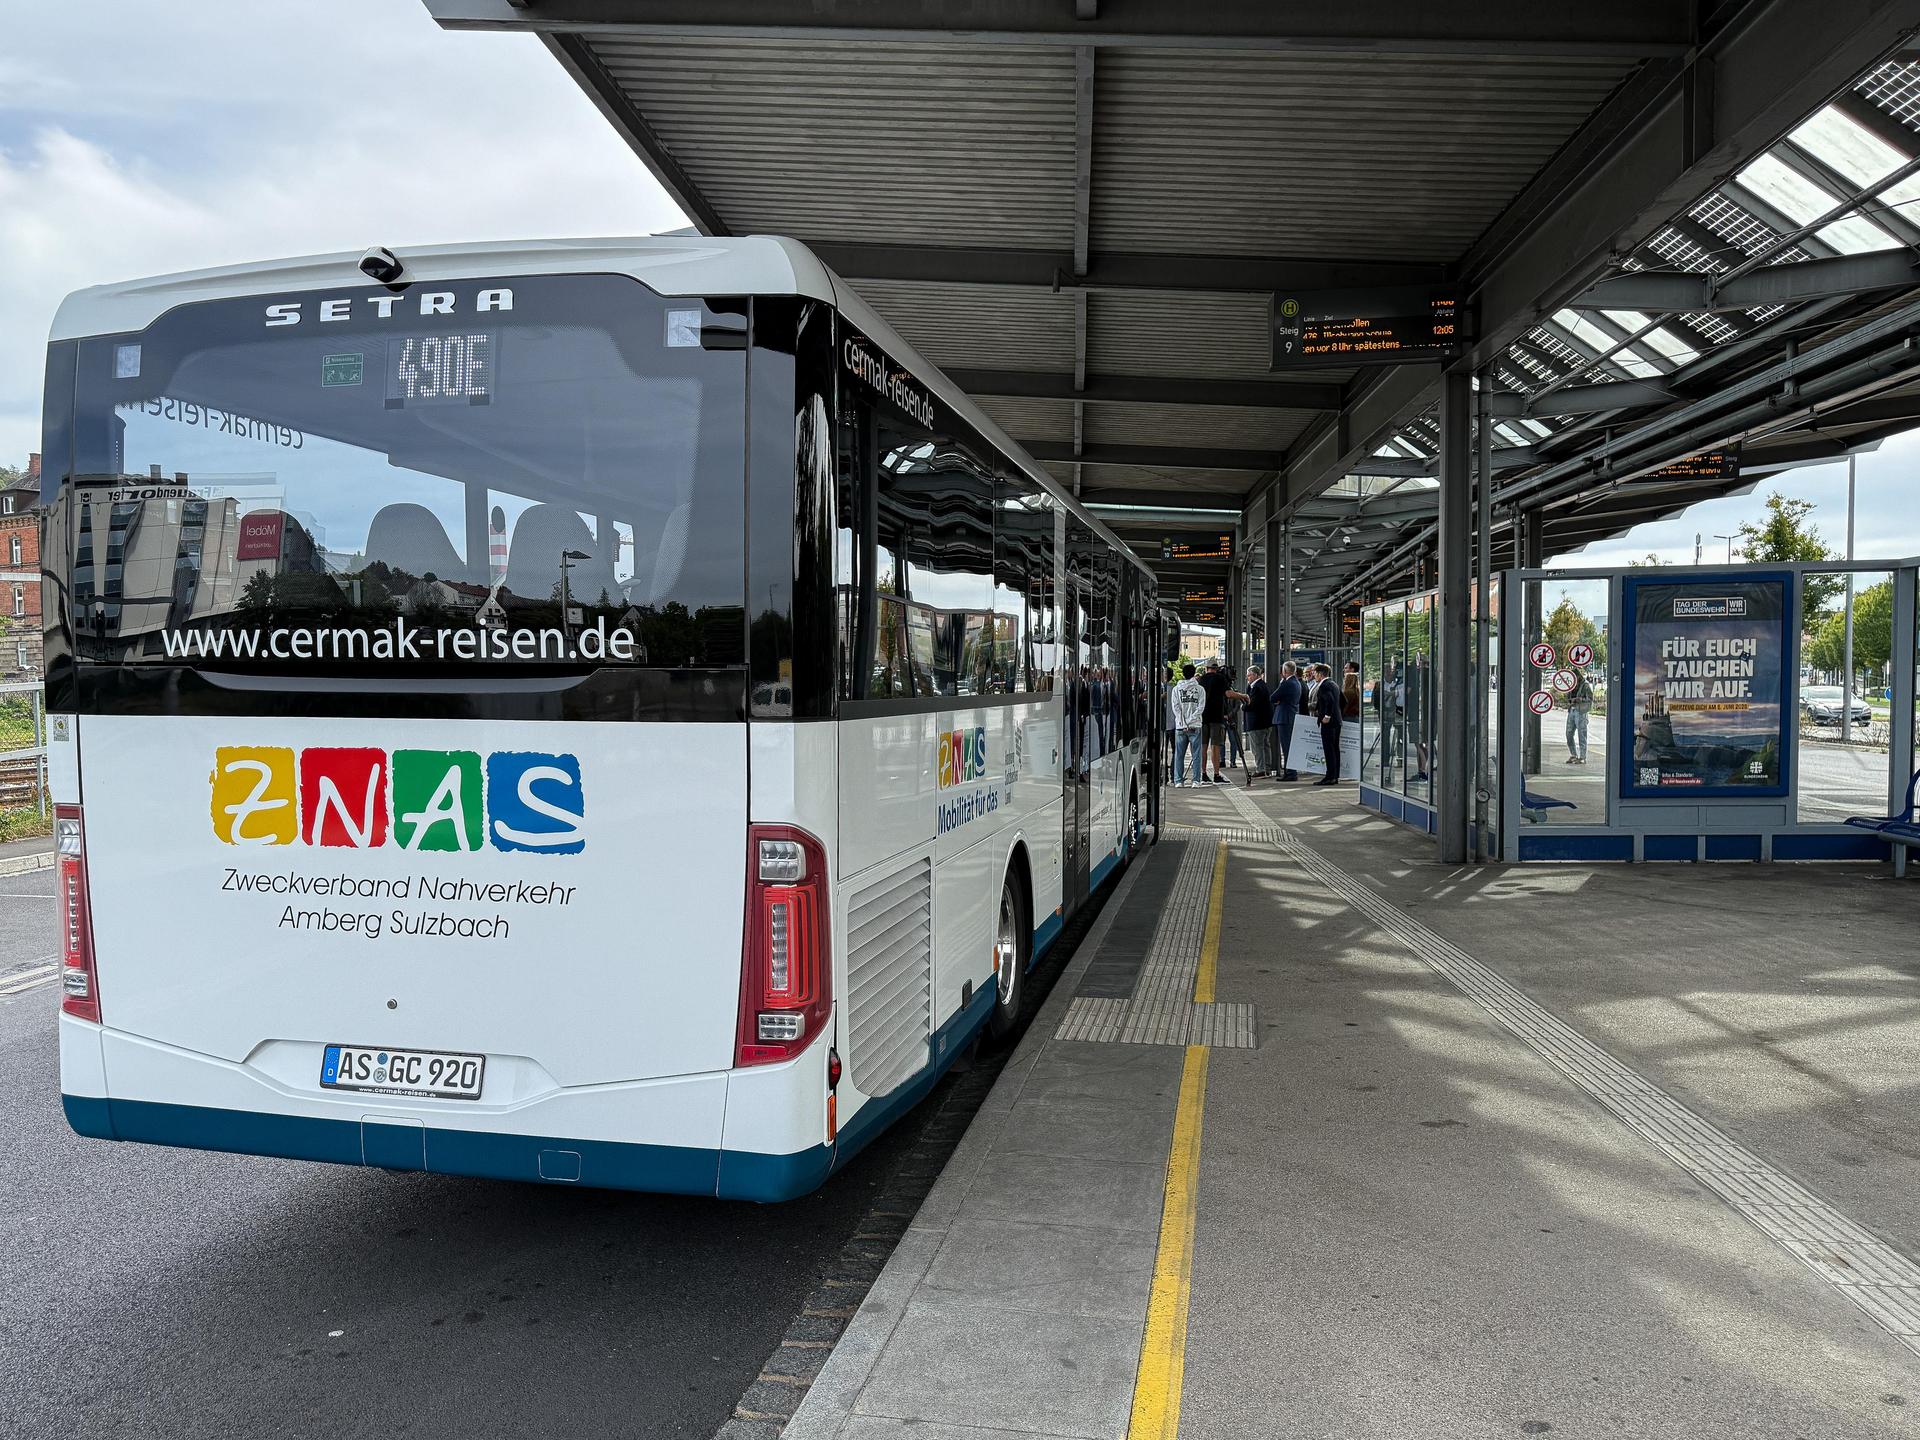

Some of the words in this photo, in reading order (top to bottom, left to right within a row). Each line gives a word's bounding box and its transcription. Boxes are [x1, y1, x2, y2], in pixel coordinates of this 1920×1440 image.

[265, 288, 513, 327] SETRA
[1280, 326, 1299, 336] Steig
[1433, 325, 1454, 335] 12:05
[1285, 341, 1293, 353] 9
[1316, 345, 1330, 353] vor
[1331, 342, 1338, 351] 8
[1338, 342, 1352, 351] Uhr
[1354, 340, 1400, 352] spätestens
[399, 334, 488, 398] 490E
[844, 338, 934, 431] cermak-reisen.de
[1676, 606, 1726, 614] BUNDESWEHR
[1729, 600, 1743, 608] WIR
[161, 616, 634, 659] www.cermak-reisen.de
[1662, 636, 1699, 658] FÜR
[1705, 639, 1757, 657] EUCH
[1664, 659, 1754, 678] TAUCHEN
[1664, 681, 1705, 699] WIR
[1710, 680, 1753, 698] AUF.
[938, 794, 975, 836] Mobilität
[975, 789, 986, 819] für
[986, 785, 998, 813] das
[221, 868, 411, 899] Zweckverband
[417, 875, 577, 905] Nahverkehr
[278, 905, 383, 938] Amberg
[389, 910, 510, 939] Sulzbach
[327, 1068, 334, 1077] D
[338, 1051, 373, 1081] AS
[388, 1055, 422, 1085] GC
[428, 1058, 477, 1089] 920
[358, 1087, 437, 1098] www.cermak-reisen.de
